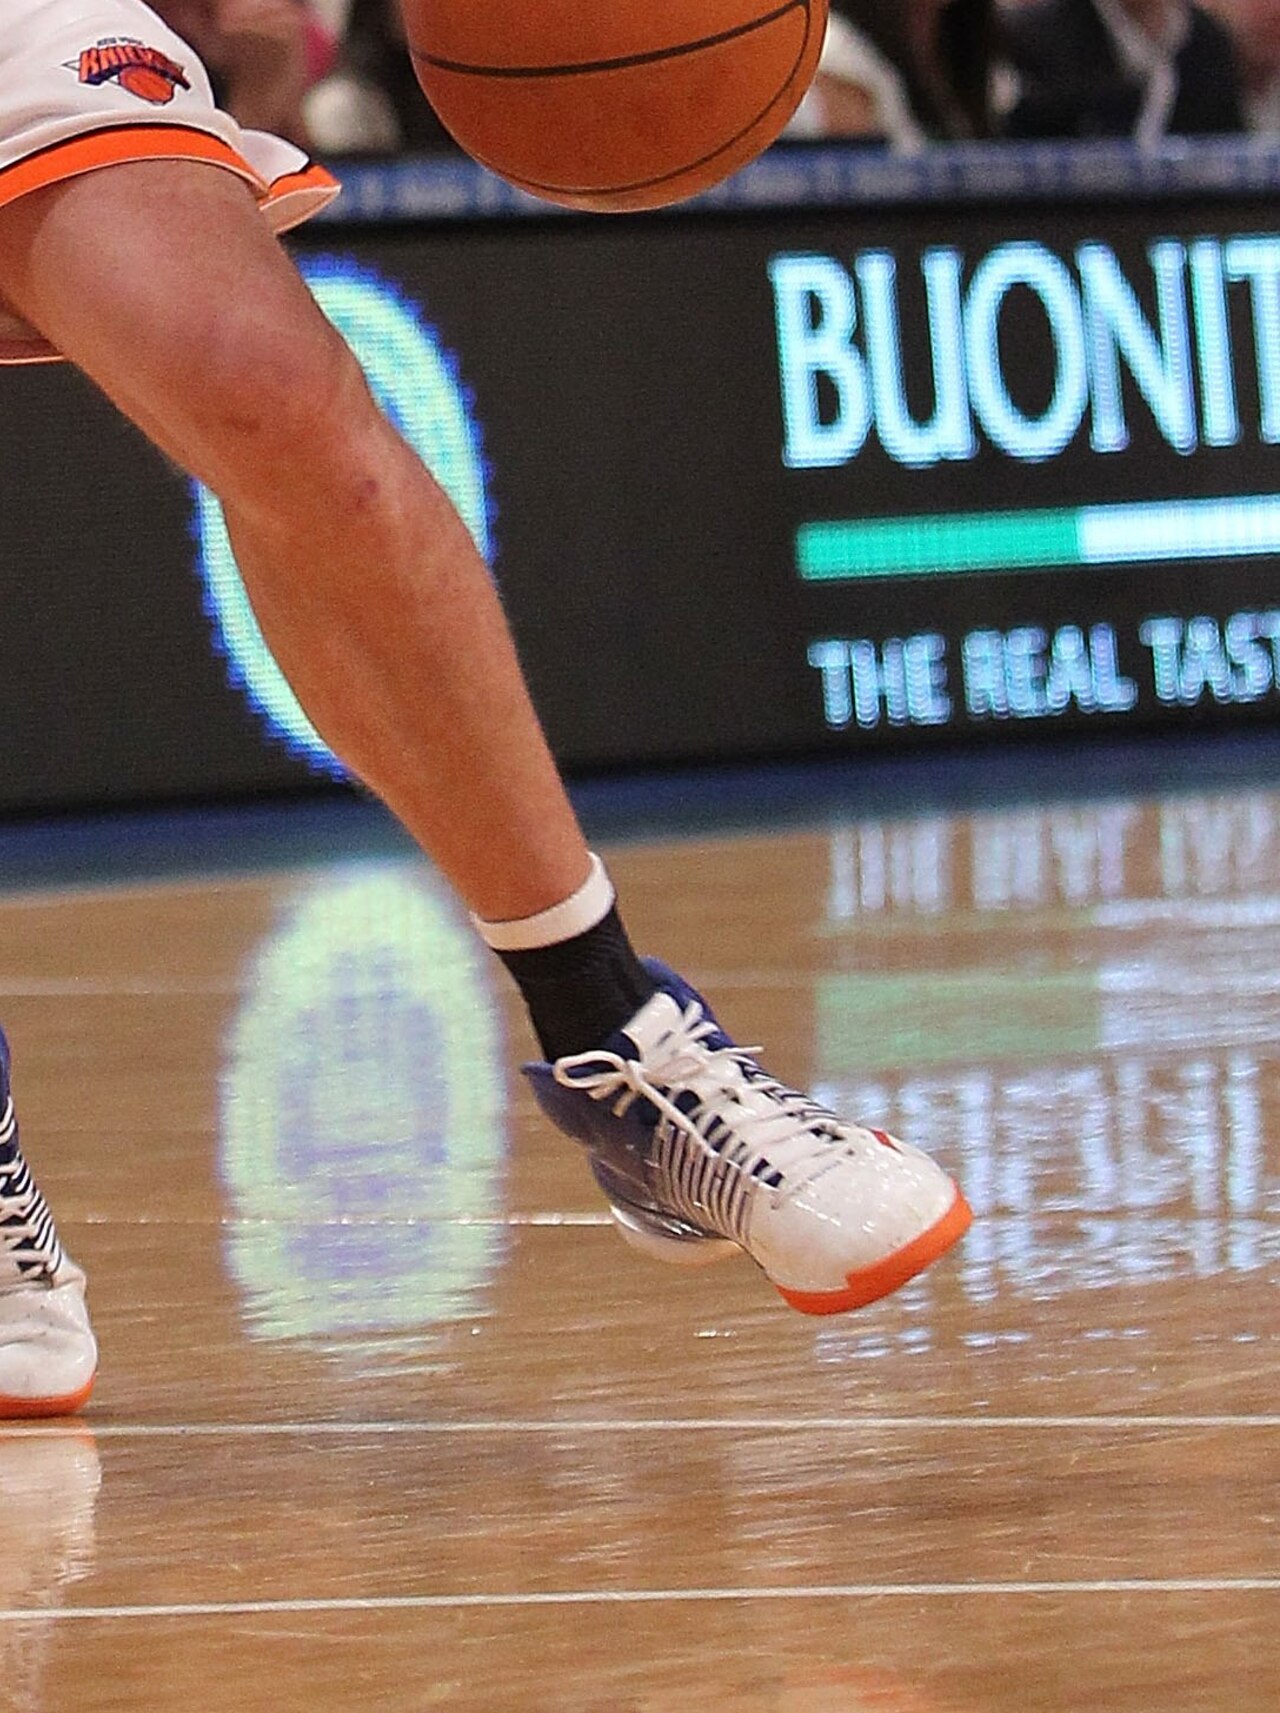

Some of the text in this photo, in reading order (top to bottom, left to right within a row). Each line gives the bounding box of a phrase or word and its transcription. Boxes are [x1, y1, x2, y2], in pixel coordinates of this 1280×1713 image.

[767, 234, 1280, 469] BUONIT
[807, 632, 953, 729] THE
[961, 622, 1138, 720] REAL
